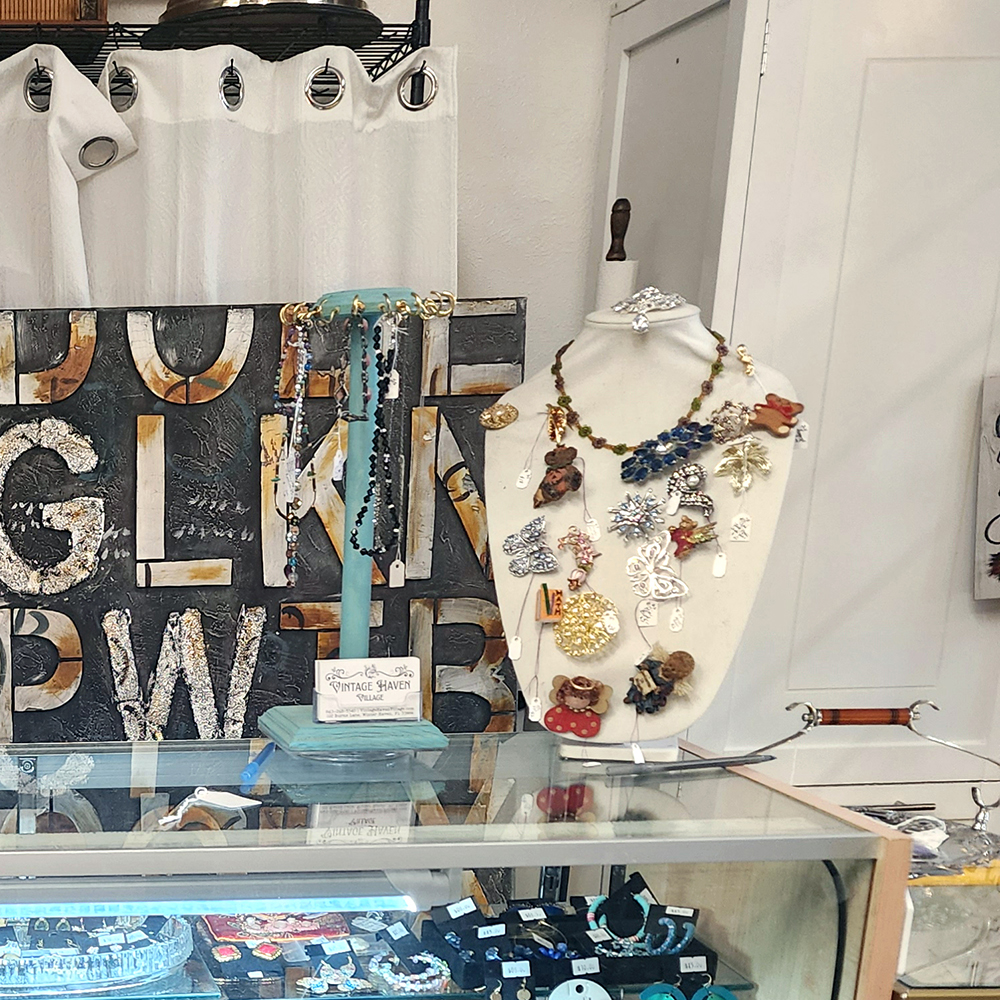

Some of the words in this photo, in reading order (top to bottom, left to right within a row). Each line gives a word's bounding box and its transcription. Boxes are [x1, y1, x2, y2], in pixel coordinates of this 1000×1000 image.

[329, 681, 373, 693] VINTAGE
[376, 680, 411, 692] HAVEN
[356, 693, 384, 702] VILLAGE
